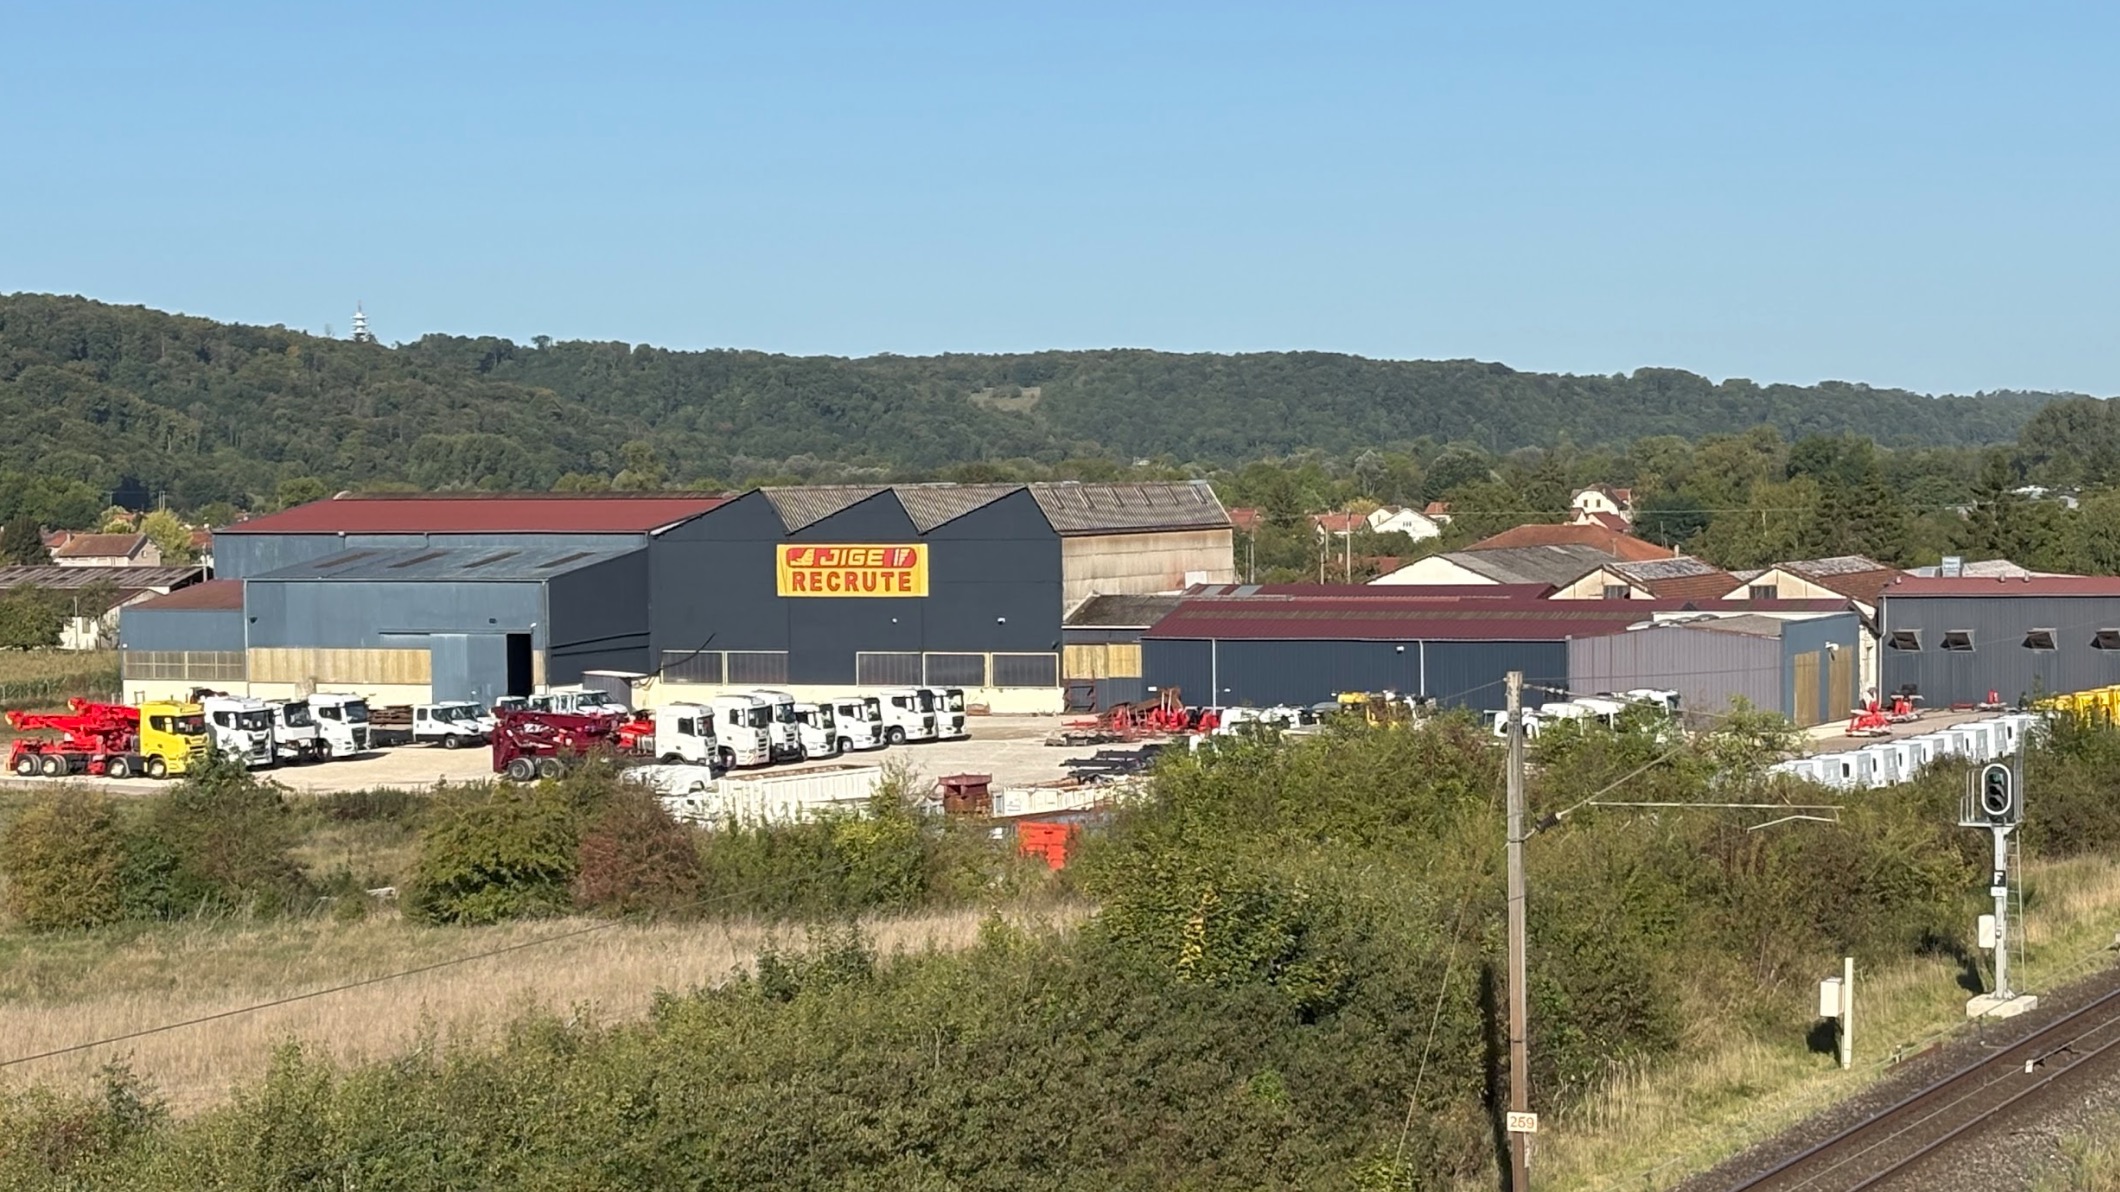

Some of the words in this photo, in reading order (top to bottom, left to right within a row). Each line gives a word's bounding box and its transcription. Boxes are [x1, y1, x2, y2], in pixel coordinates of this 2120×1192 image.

[819, 549, 885, 567] JIGE
[792, 571, 912, 592] RECRUTE
[1994, 871, 2004, 885] F
[1510, 1115, 1535, 1129] 259
